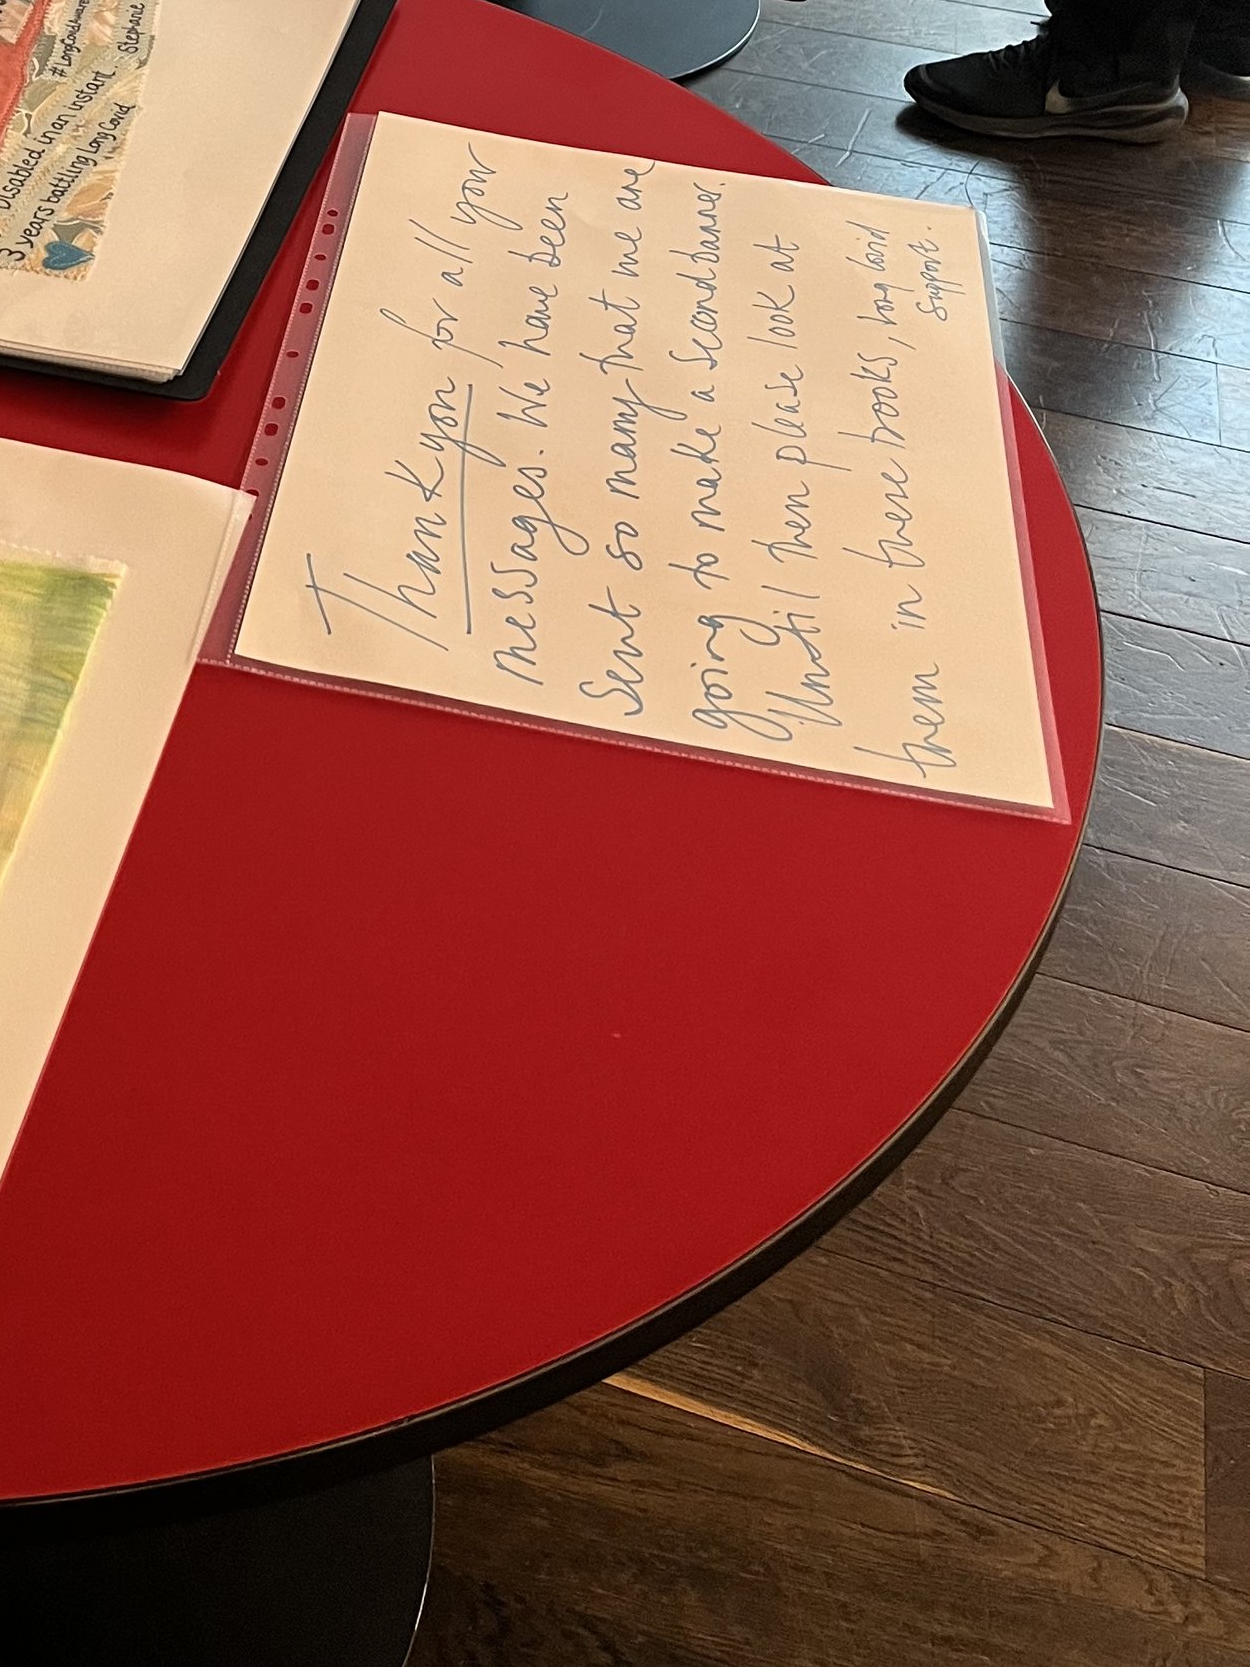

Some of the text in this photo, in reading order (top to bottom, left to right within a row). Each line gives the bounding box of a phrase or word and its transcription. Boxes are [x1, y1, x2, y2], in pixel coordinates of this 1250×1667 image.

[117, 2, 145, 54] Stephanie
[41, 128, 54, 145] in
[51, 114, 74, 137] an
[64, 65, 118, 117] instant.
[17, 199, 54, 256] years
[48, 155, 98, 210] battling
[76, 128, 113, 167] Long
[105, 103, 136, 135] Covid
[616, 161, 656, 211] are
[409, 219, 473, 287] all
[611, 226, 642, 278] we
[379, 297, 503, 368] for
[579, 288, 644, 375] that
[419, 376, 506, 468] you
[691, 384, 715, 403] a
[838, 337, 916, 449] books,
[490, 192, 590, 686] messages. We have been
[606, 378, 688, 500] many
[670, 424, 726, 532] make
[746, 234, 852, 726] Until then please look at
[306, 457, 449, 652] Thank
[606, 521, 642, 571] so
[842, 457, 926, 568] these
[668, 553, 730, 590] to
[890, 584, 926, 630] in
[692, 615, 793, 742] going
[853, 662, 957, 778] them
